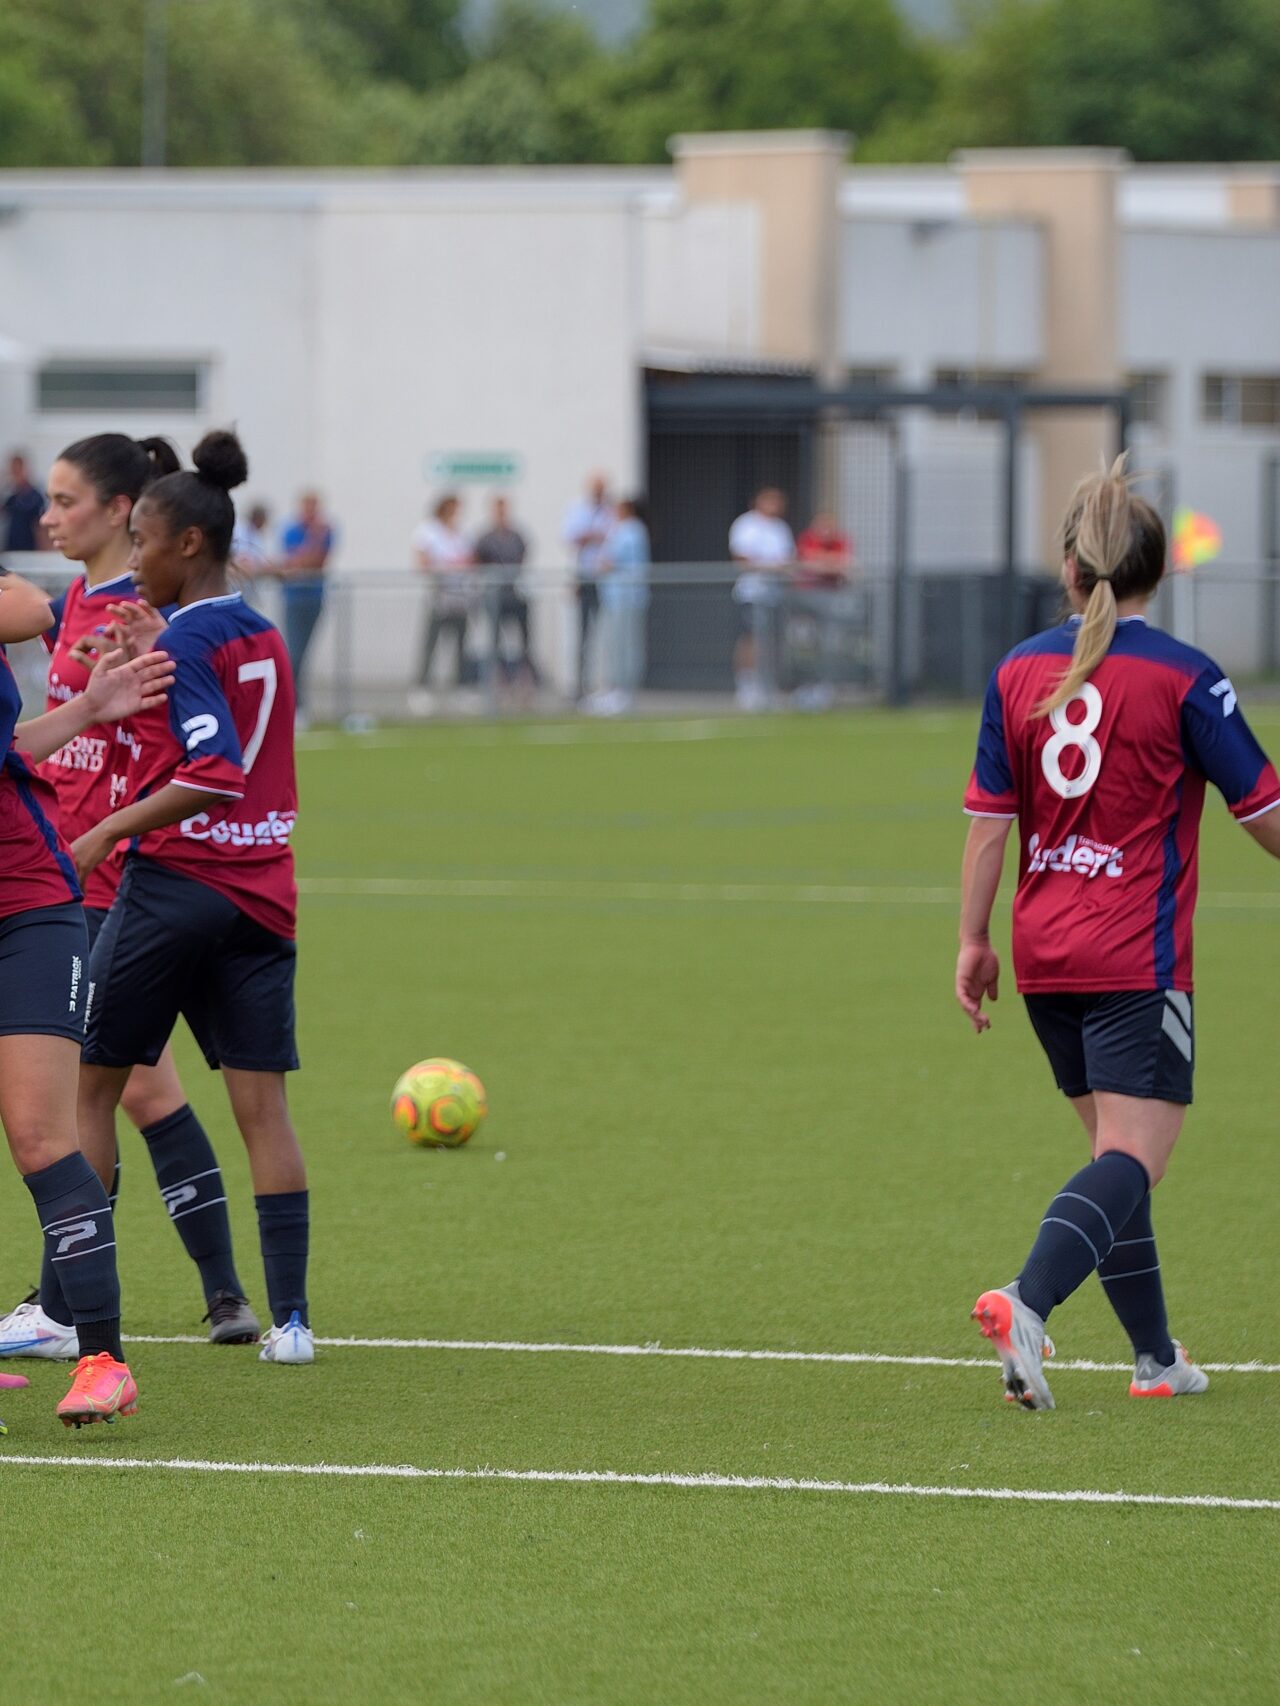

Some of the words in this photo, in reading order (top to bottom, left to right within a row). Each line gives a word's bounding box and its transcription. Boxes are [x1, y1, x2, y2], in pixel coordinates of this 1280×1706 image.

[238, 657, 277, 775] 7
[1041, 681, 1103, 799] 8
[70, 955, 79, 999] PATRICK
